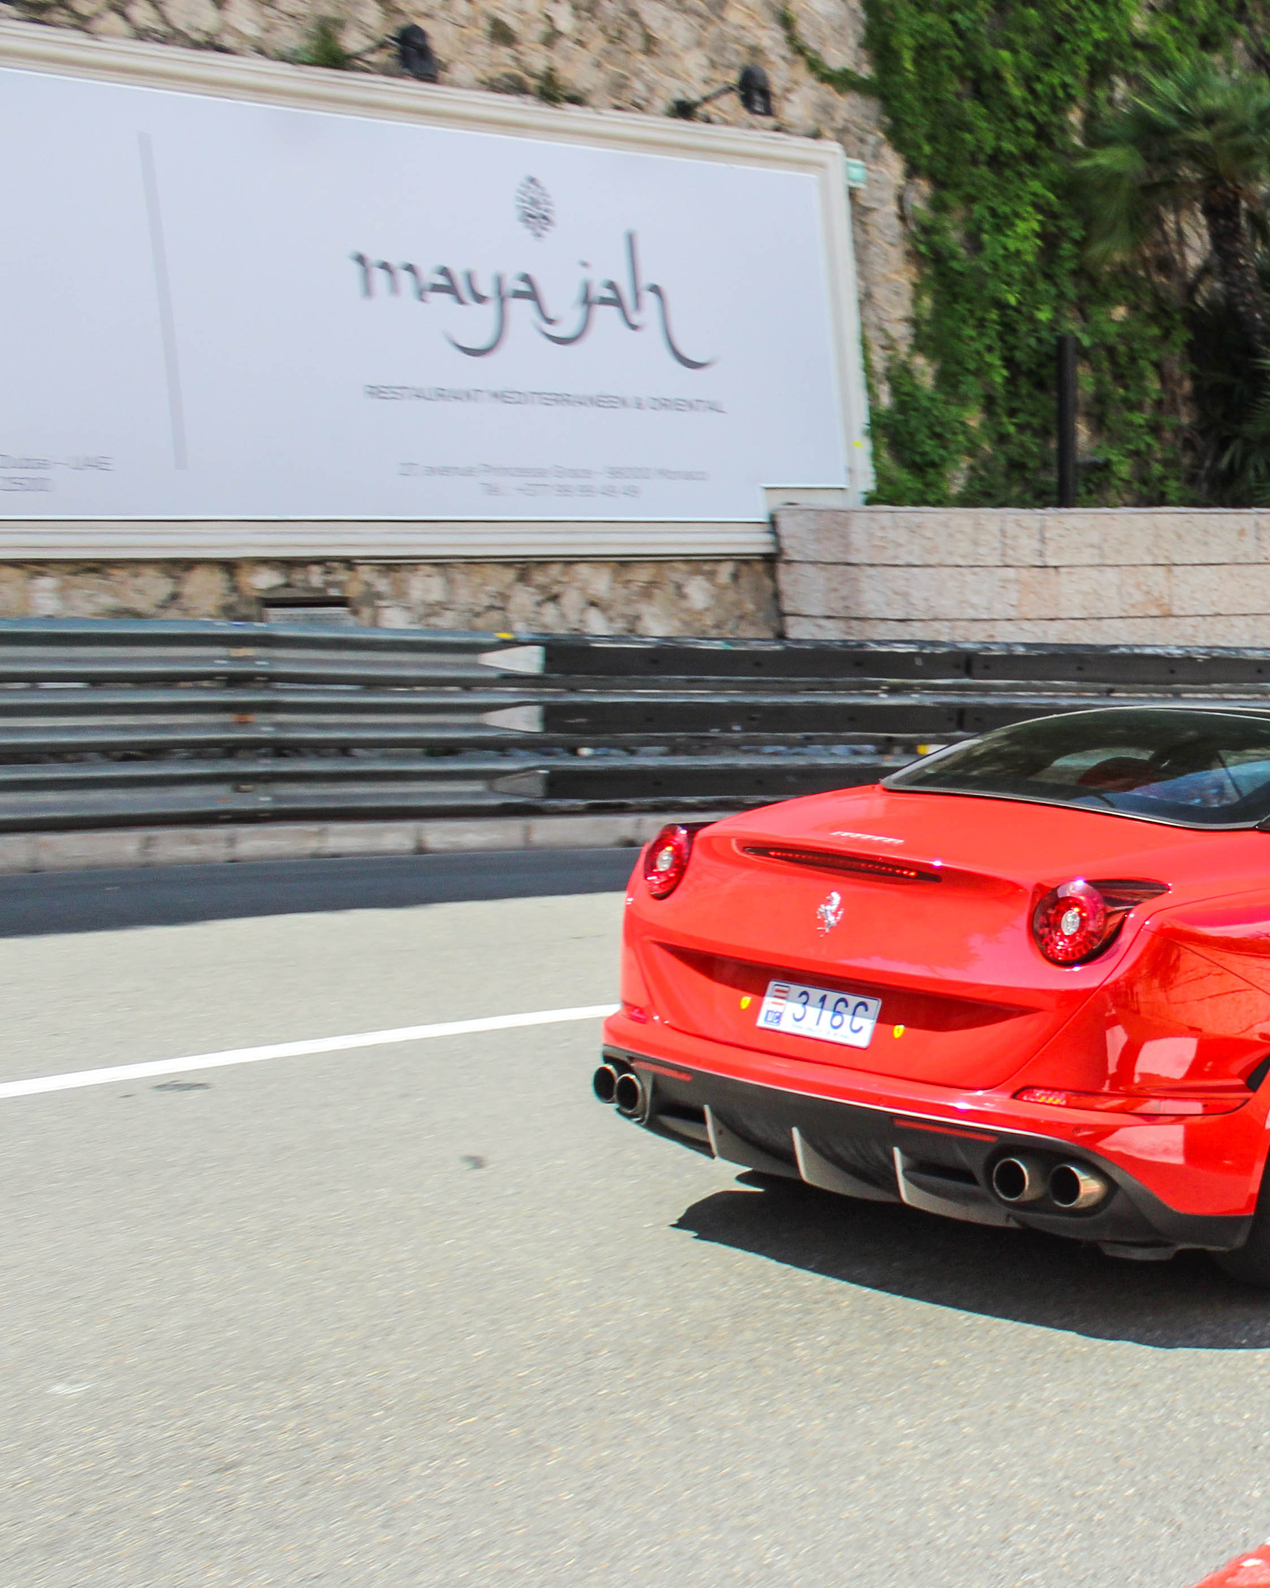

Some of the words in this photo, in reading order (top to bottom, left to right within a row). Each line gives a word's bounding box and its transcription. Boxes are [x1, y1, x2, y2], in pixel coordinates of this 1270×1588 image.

[349, 250, 559, 357] maya
[533, 228, 718, 370] jah
[362, 384, 486, 403] RESTAURANT
[633, 395, 646, 410] &
[648, 396, 728, 414] ORIENTAL
[792, 990, 868, 1034] 316C
